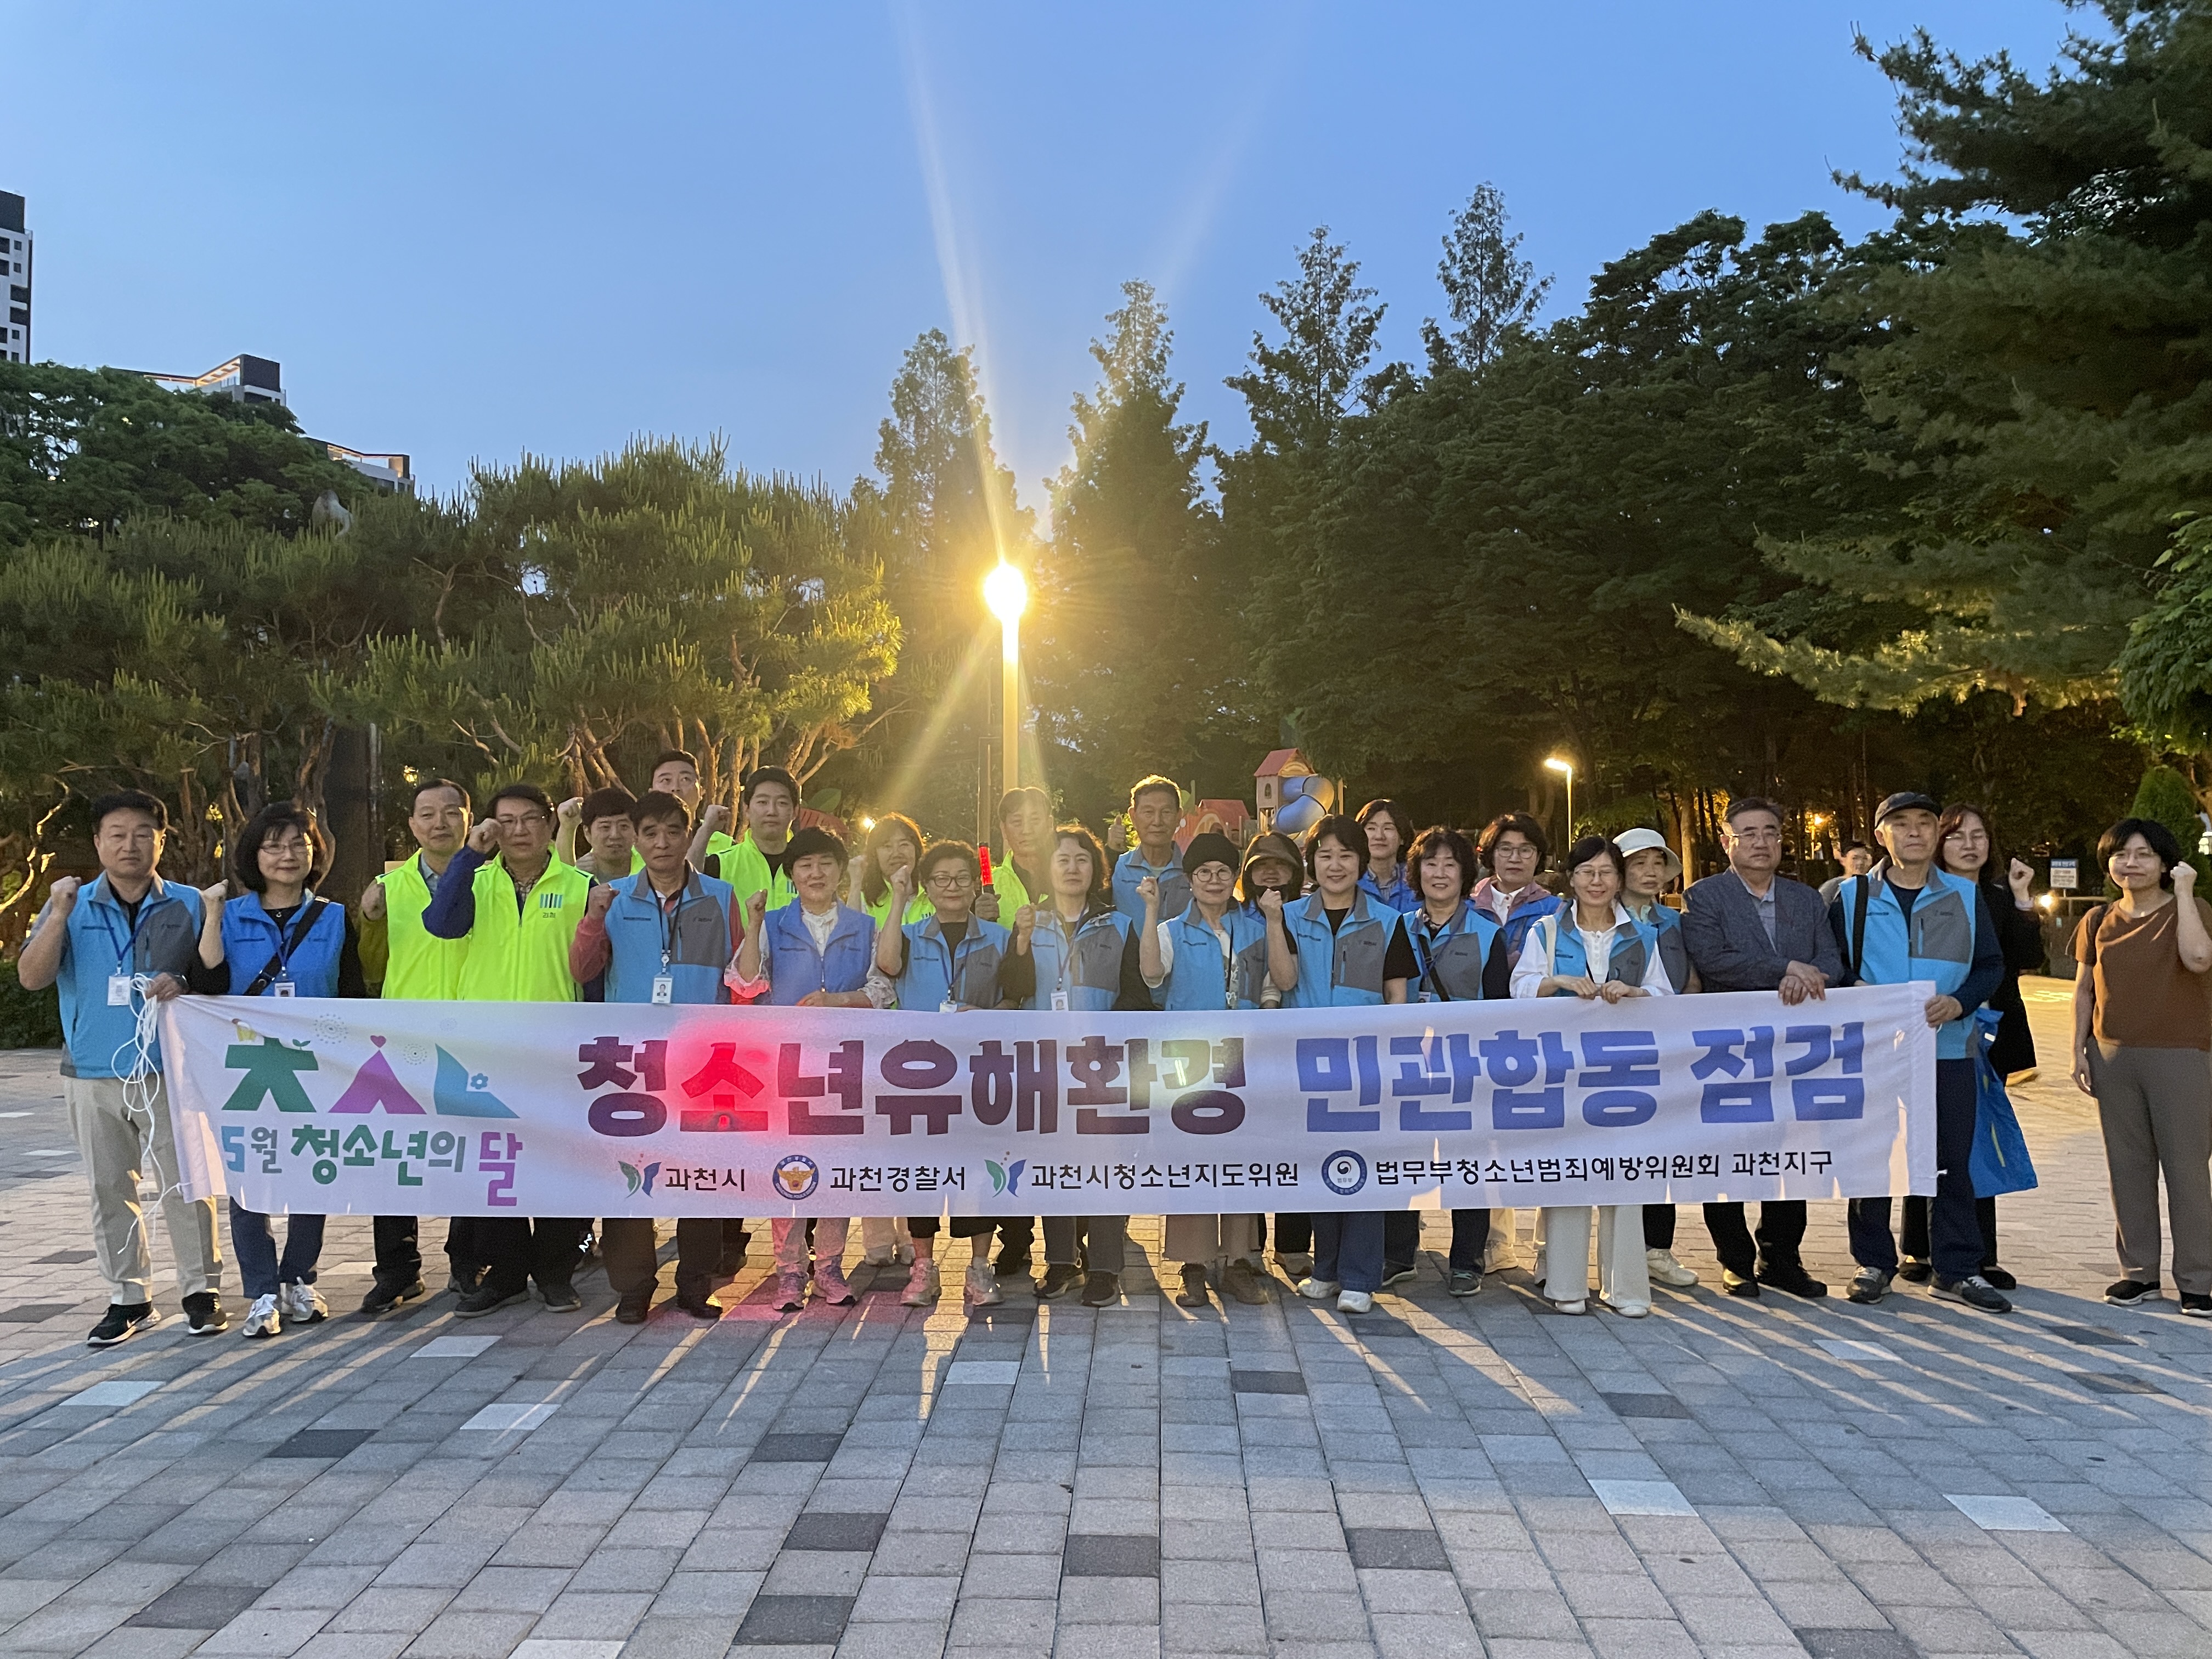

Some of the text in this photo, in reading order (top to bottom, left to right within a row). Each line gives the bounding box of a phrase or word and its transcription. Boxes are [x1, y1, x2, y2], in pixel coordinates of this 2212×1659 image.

[577, 1022, 1865, 1137] 청소년유해환경 민관합동 점검
[221, 1125, 523, 1206] 5월 청소년의 달
[665, 1168, 745, 1192] 과천시
[830, 1166, 964, 1192] 과천경찰서
[1031, 1163, 1298, 1189] 과천시청소년지도위원
[1376, 1154, 1719, 1185] 법무부청소년범죄예방위원회
[1732, 1151, 1832, 1176] 과천지구
